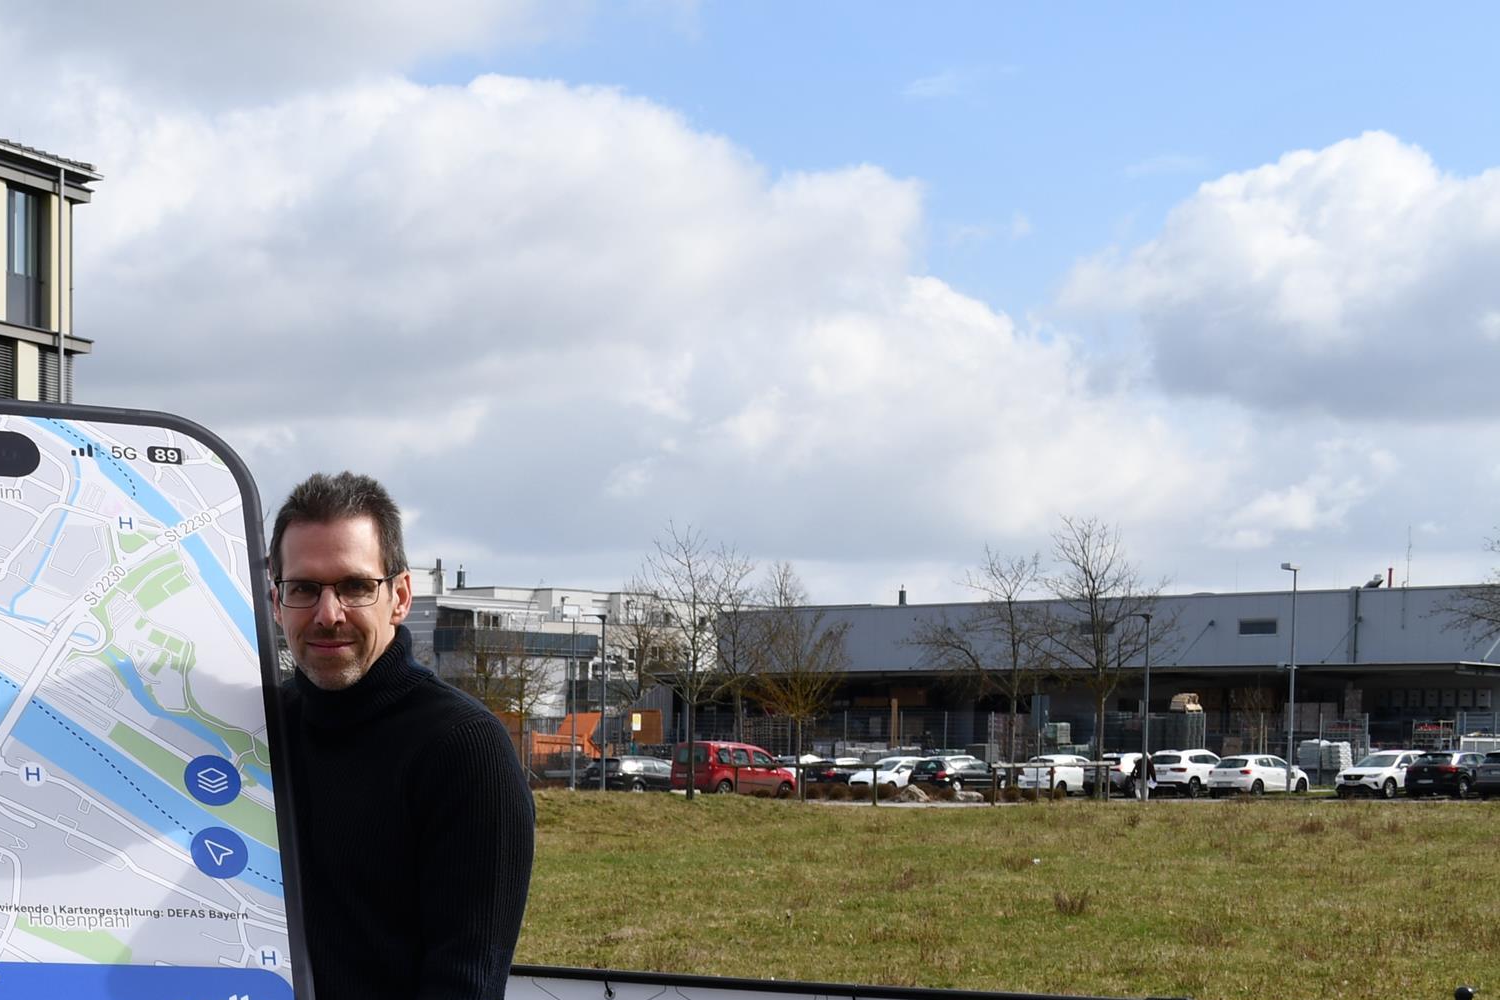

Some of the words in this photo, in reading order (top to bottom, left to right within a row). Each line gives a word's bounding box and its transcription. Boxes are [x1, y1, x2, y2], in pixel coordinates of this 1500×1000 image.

[111, 446, 138, 461] 5G
[154, 448, 179, 463] 89
[119, 516, 133, 530] H
[164, 526, 181, 543] St
[181, 511, 212, 537] 2230
[84, 588, 100, 606] St
[96, 565, 126, 595] 2230
[25, 766, 41, 782] H
[60, 905, 164, 919] Kartengestaltung:
[168, 908, 206, 919] DEFAS
[209, 909, 249, 921] Bayern
[261, 950, 277, 966] H
